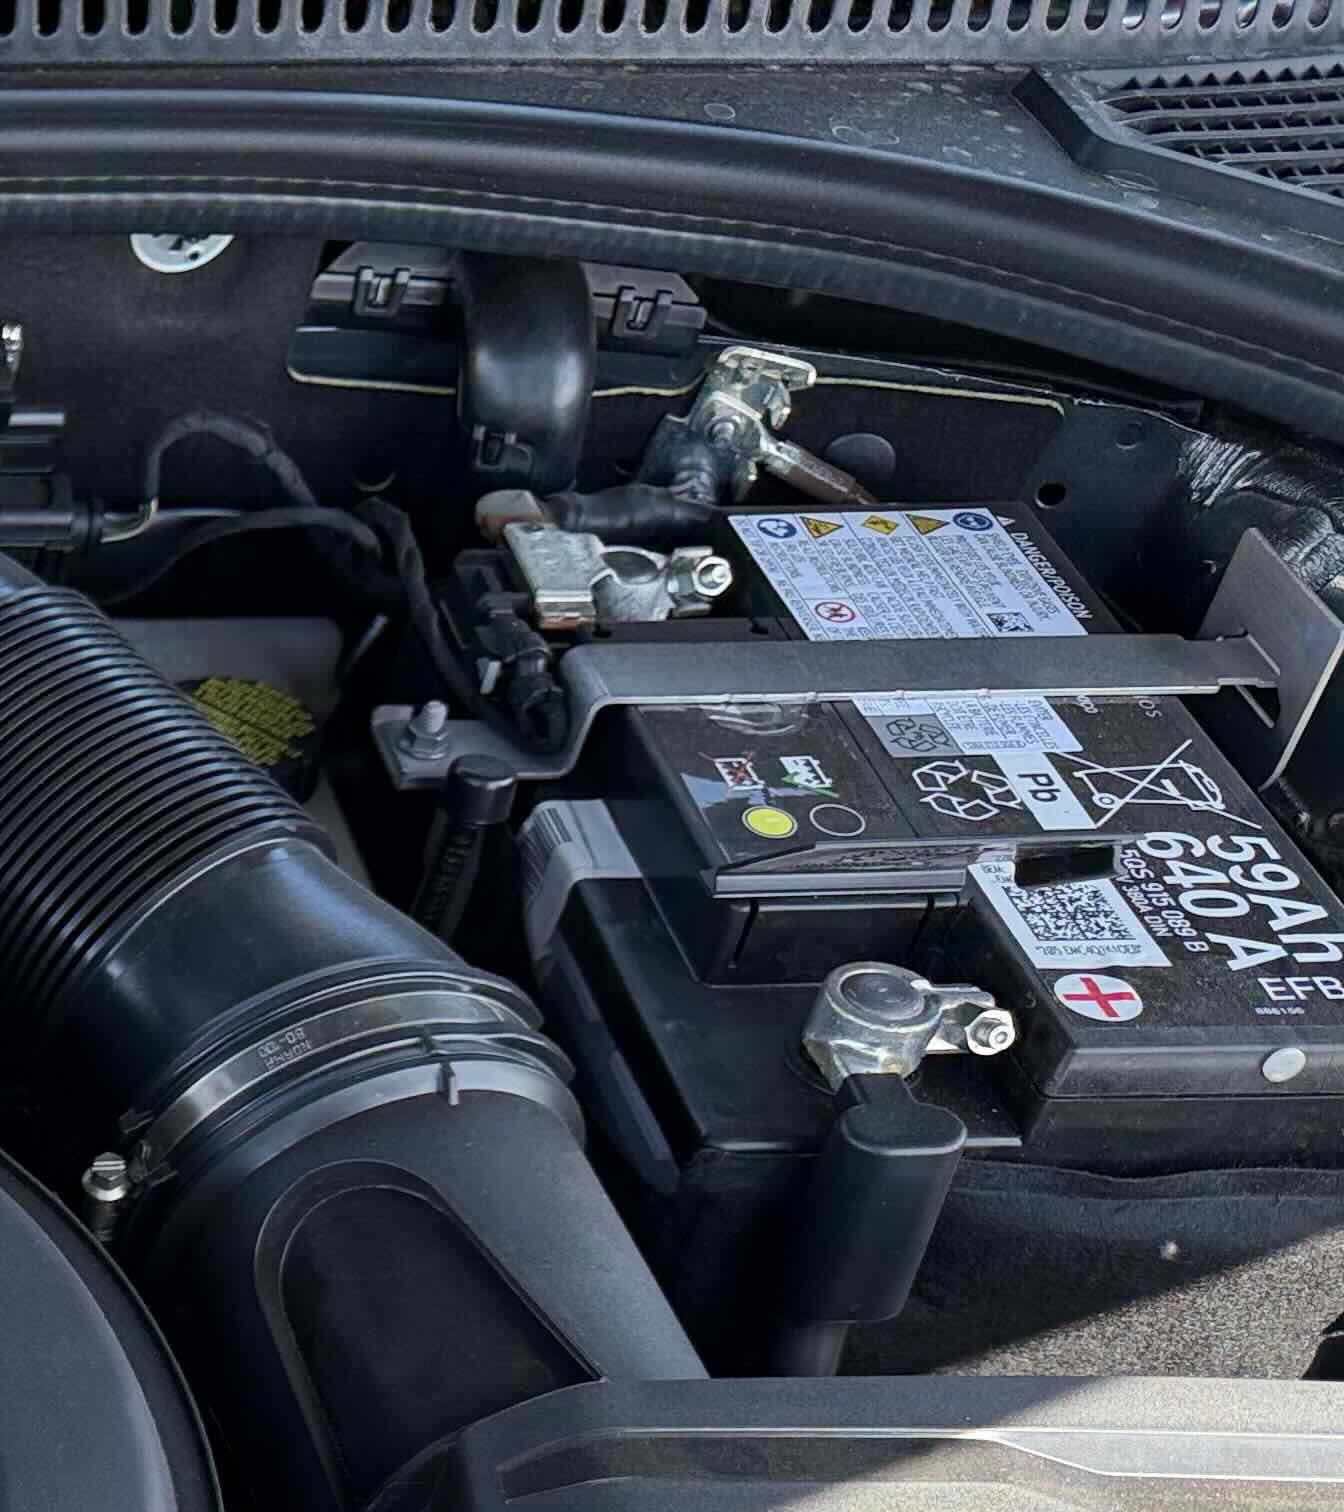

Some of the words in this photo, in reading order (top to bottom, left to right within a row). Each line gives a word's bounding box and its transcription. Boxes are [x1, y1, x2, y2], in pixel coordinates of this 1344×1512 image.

[1012, 532, 1093, 620] DANGER/POISON
[1016, 773, 1062, 802] Pb
[1136, 831, 1250, 918] 640
[1206, 931, 1289, 972] A
[1140, 882, 1174, 911] 915
[1162, 909, 1197, 939] 089
[1207, 834, 1344, 963] 59Ah
[1258, 976, 1344, 1001] EFB
